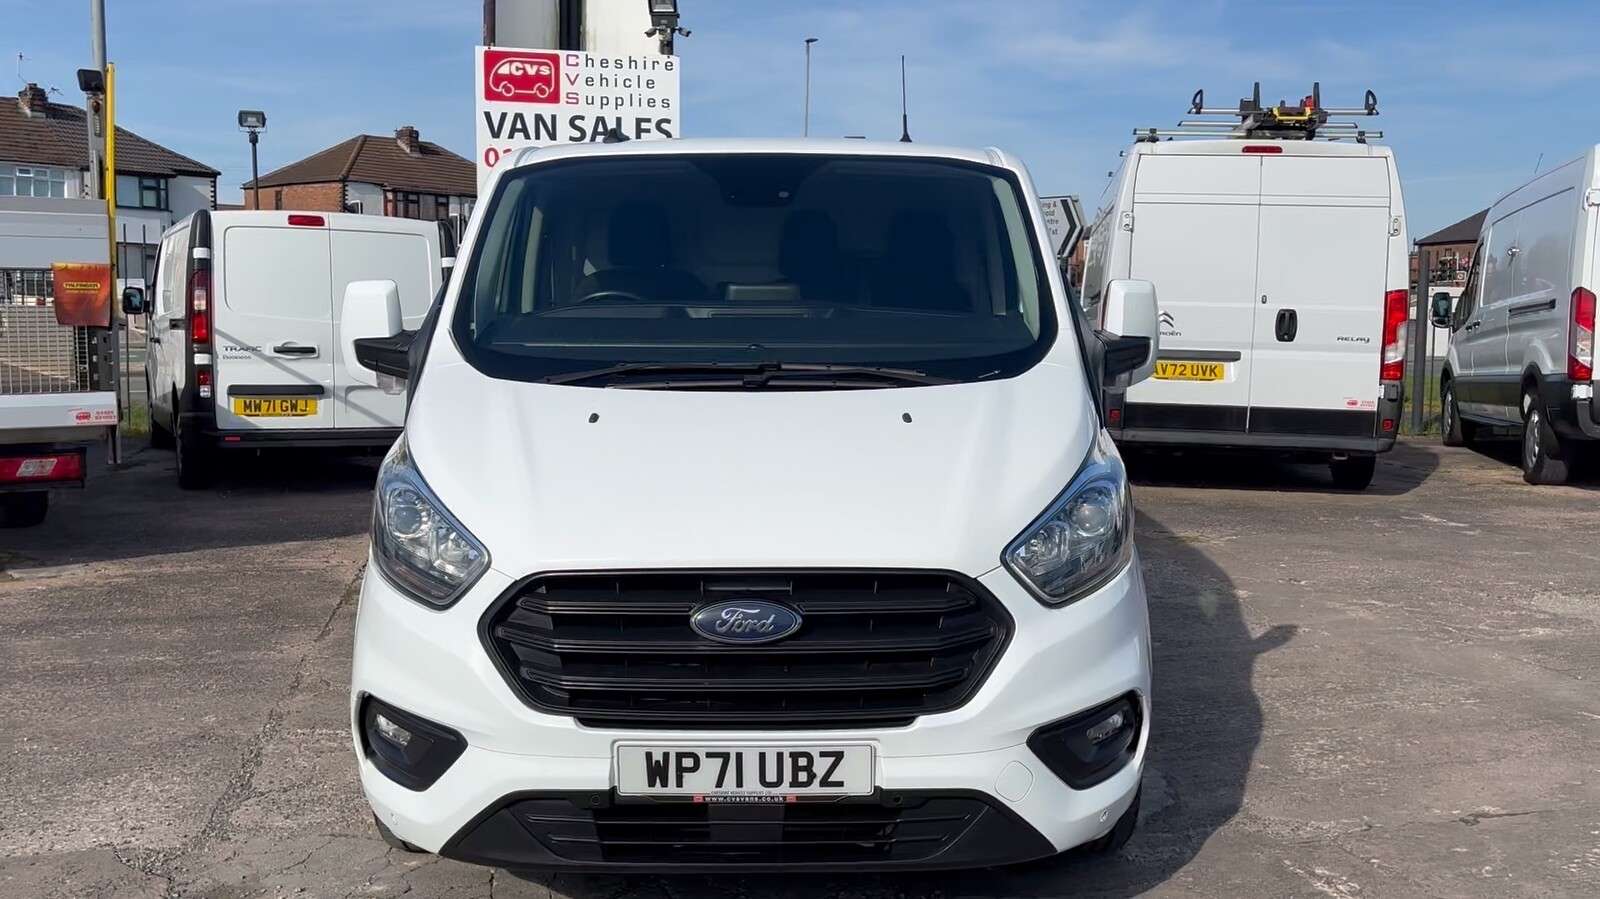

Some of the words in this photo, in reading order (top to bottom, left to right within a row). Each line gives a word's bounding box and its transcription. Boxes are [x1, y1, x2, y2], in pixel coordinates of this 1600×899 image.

[510, 61, 551, 76] CVS
[565, 53, 674, 71] Cheshire
[565, 73, 656, 89] Vehicle
[565, 92, 670, 109] Supplies
[483, 111, 557, 140] VAN
[1190, 364, 1218, 377] UVK
[243, 399, 276, 413] MW71
[280, 399, 309, 413] GWJ
[715, 607, 776, 634] Ford
[645, 751, 744, 789] WP71
[758, 751, 845, 789] UBZ
